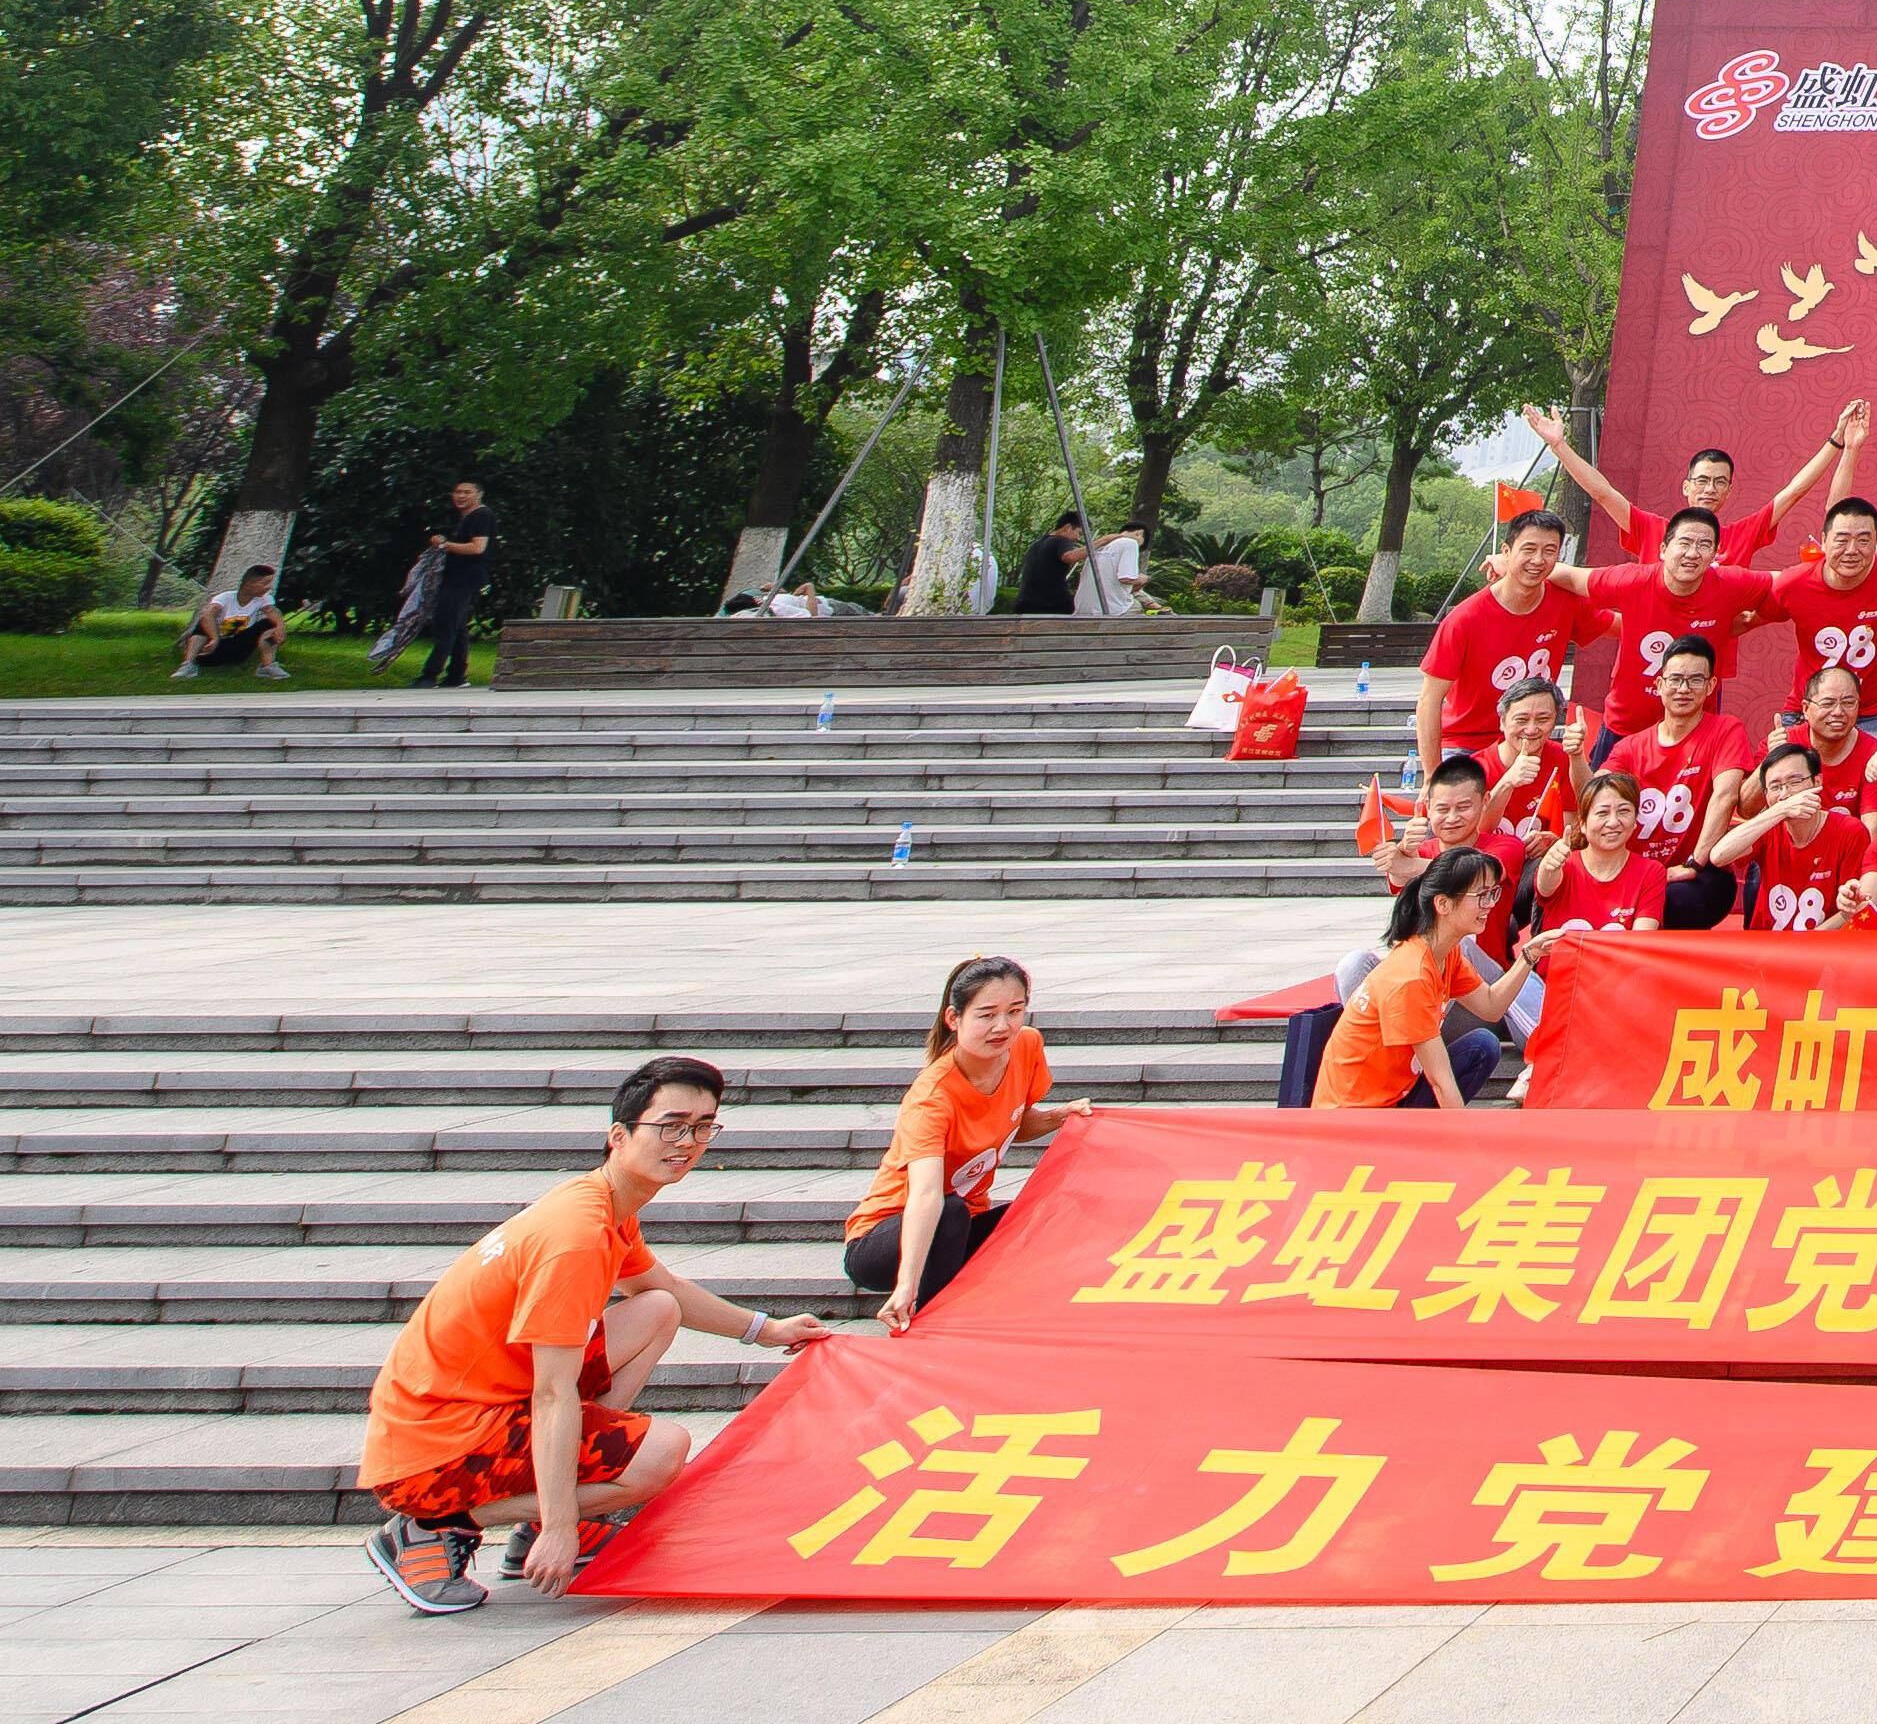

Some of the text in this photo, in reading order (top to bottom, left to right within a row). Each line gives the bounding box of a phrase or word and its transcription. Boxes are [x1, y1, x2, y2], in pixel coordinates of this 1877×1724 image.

[1815, 625, 1875, 668] 98
[1637, 784, 1694, 839] 98
[1769, 883, 1824, 930] 98
